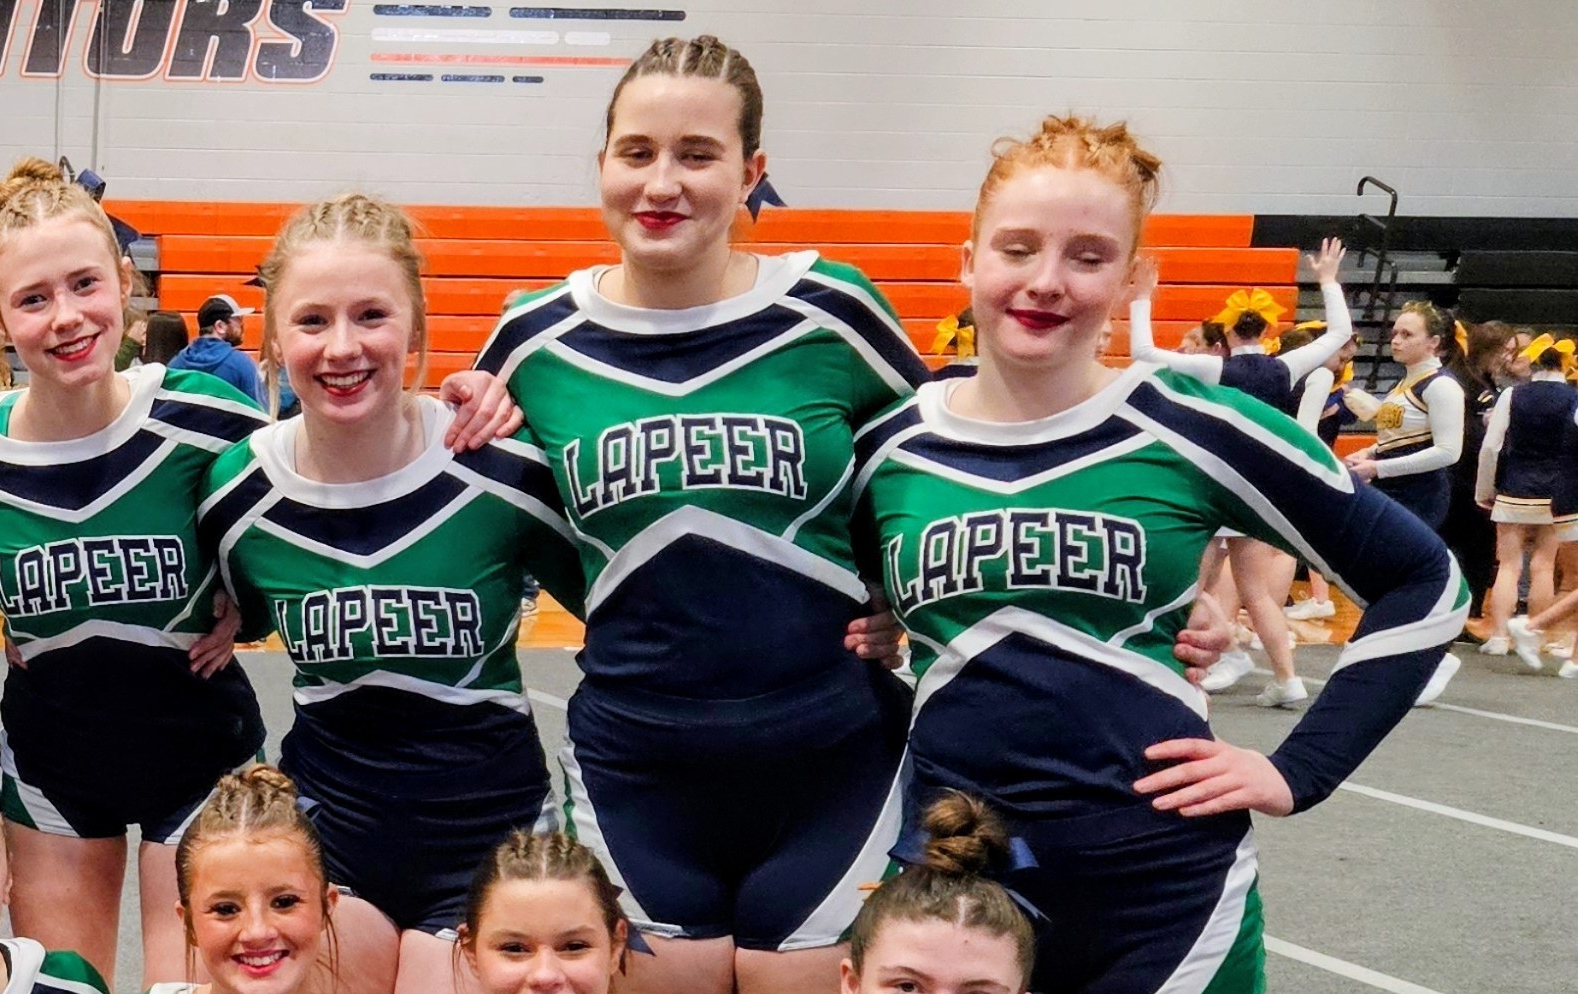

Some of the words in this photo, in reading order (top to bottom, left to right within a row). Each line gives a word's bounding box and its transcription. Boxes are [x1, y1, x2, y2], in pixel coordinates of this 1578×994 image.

[564, 412, 808, 519] LAPEER
[887, 508, 1147, 618] LAPEER
[275, 584, 484, 663] LAPEER
